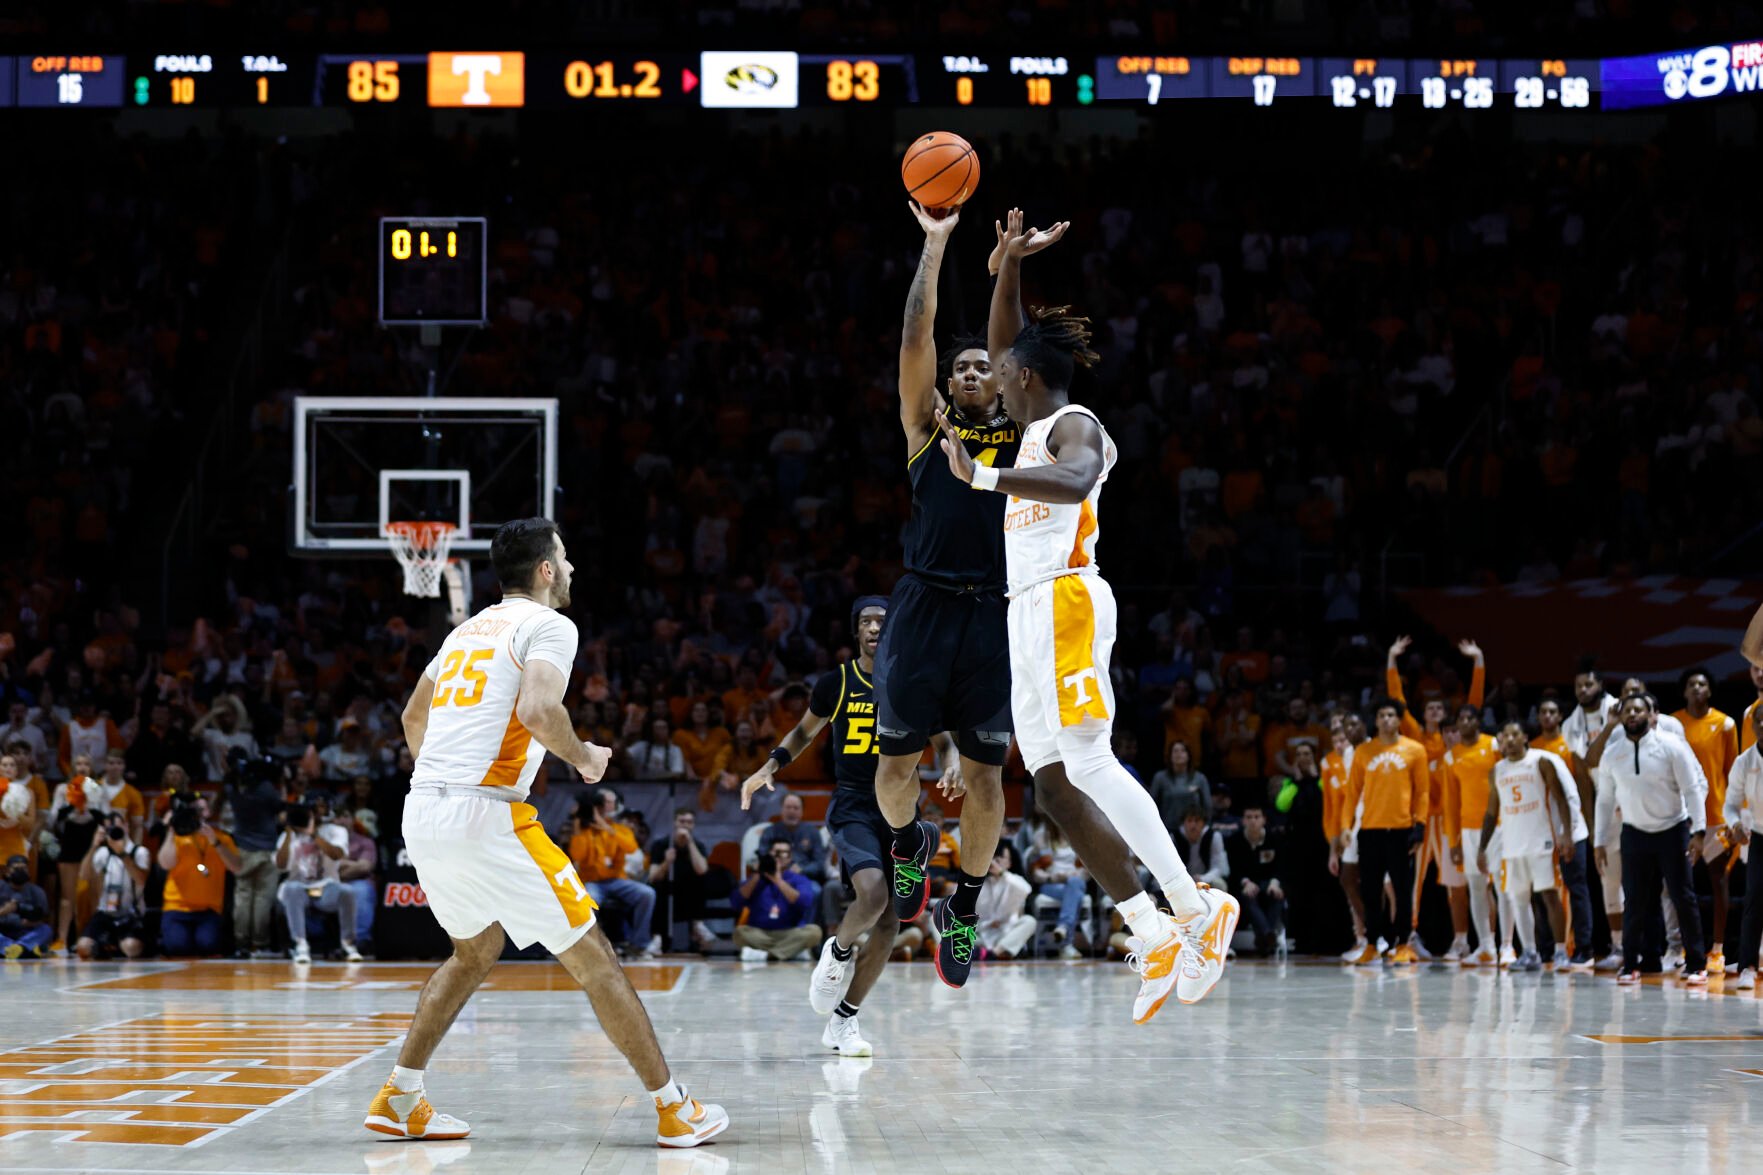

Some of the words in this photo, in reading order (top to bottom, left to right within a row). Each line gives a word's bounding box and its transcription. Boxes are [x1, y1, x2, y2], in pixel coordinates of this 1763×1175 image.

[32, 57, 67, 72] OFF
[154, 55, 213, 72] FOULS
[1010, 57, 1068, 75] FOULS
[1118, 57, 1153, 73] OFF
[1688, 46, 1730, 98] 8
[57, 74, 83, 103] 15
[170, 75, 195, 104] 10
[256, 75, 269, 105] 1
[348, 61, 400, 101] 85
[451, 55, 501, 105] T
[565, 61, 660, 98] 01.2
[827, 61, 879, 100] 83
[956, 76, 973, 106] 0
[1026, 77, 1051, 106] 10
[1146, 73, 1162, 105] 7
[1252, 75, 1277, 106] 17
[391, 229, 456, 260] 01.1
[953, 426, 1015, 446] MIZZOU
[432, 648, 495, 709] 25
[1063, 666, 1096, 708] T
[1512, 786, 1522, 802] 5
[554, 862, 588, 902] T
